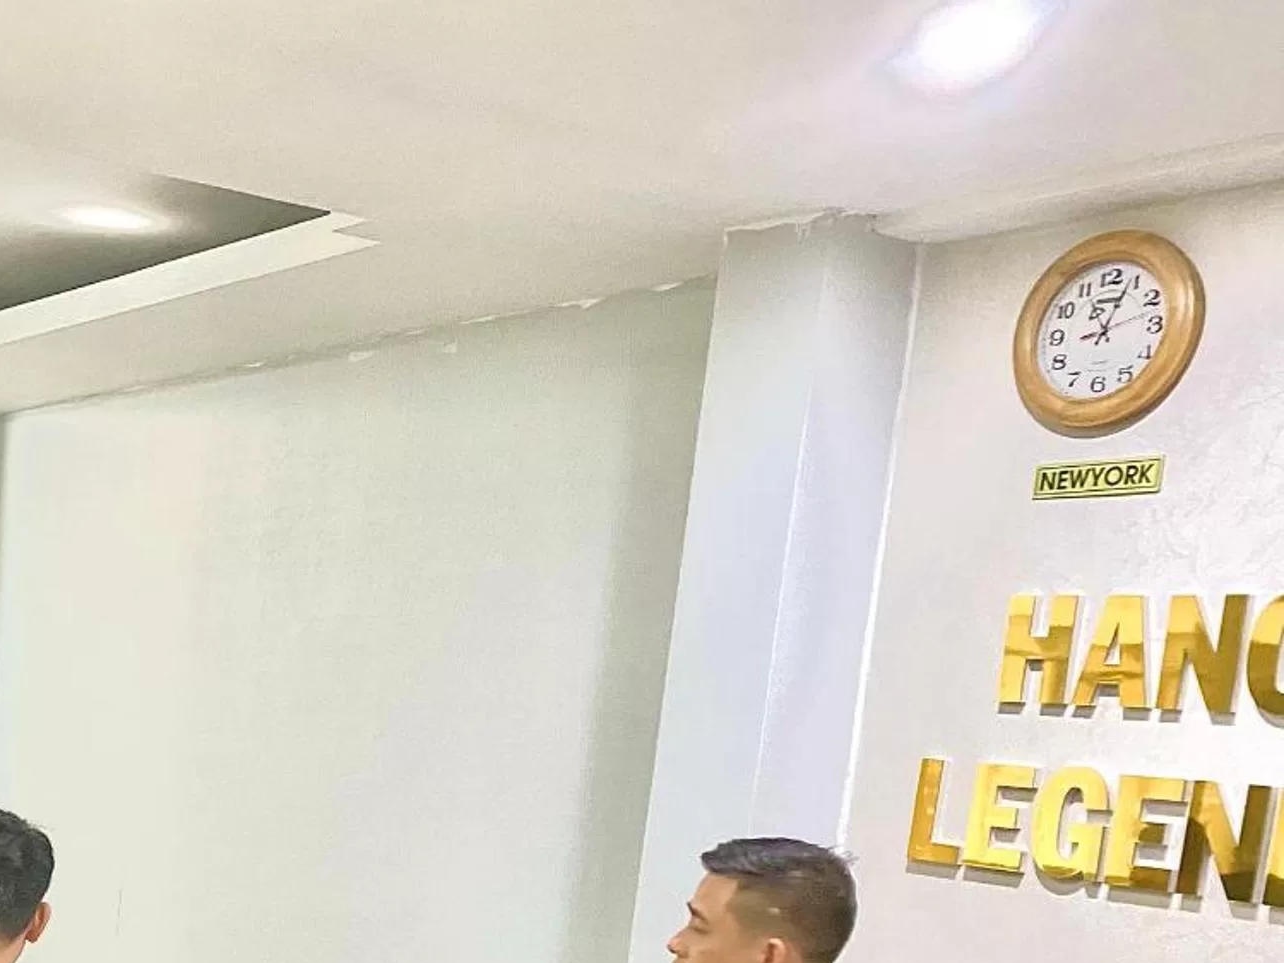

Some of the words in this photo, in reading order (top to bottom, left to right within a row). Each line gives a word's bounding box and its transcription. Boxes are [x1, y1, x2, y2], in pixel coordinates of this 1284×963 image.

[1100, 268, 1123, 287] 12
[1132, 275, 1140, 289] 1
[1078, 283, 1092, 298] 11
[1143, 289, 1161, 307] 2
[1056, 302, 1075, 319] 10
[1146, 315, 1163, 334] 3
[1049, 329, 1065, 346] 9
[1138, 344, 1152, 360] 4
[1052, 354, 1067, 370] 8
[1068, 371, 1081, 387] 7
[1117, 365, 1134, 383] 5
[1090, 376, 1105, 393] 6
[1039, 463, 1155, 491] NEWYORK
[906, 757, 1284, 908] LEGEN
